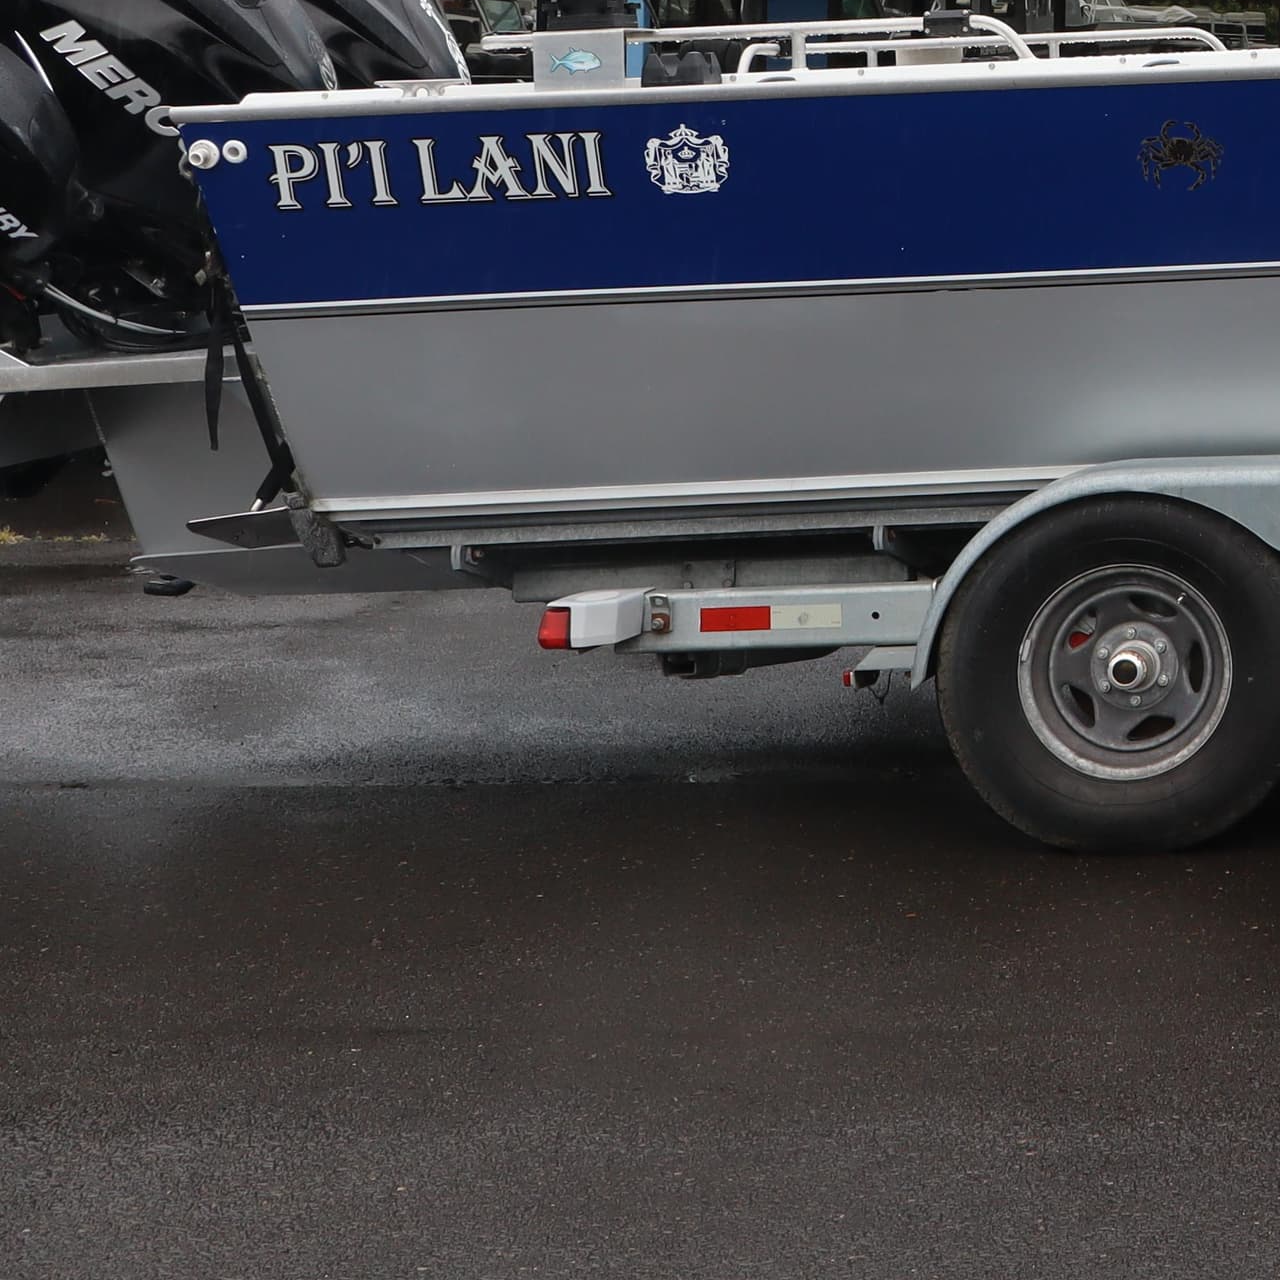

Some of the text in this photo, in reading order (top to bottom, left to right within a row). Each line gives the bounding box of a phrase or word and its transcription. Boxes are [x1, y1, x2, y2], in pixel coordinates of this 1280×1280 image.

[39, 19, 182, 138] MERC
[267, 130, 612, 210] PI'I LANI
[0, 207, 41, 239] RY
